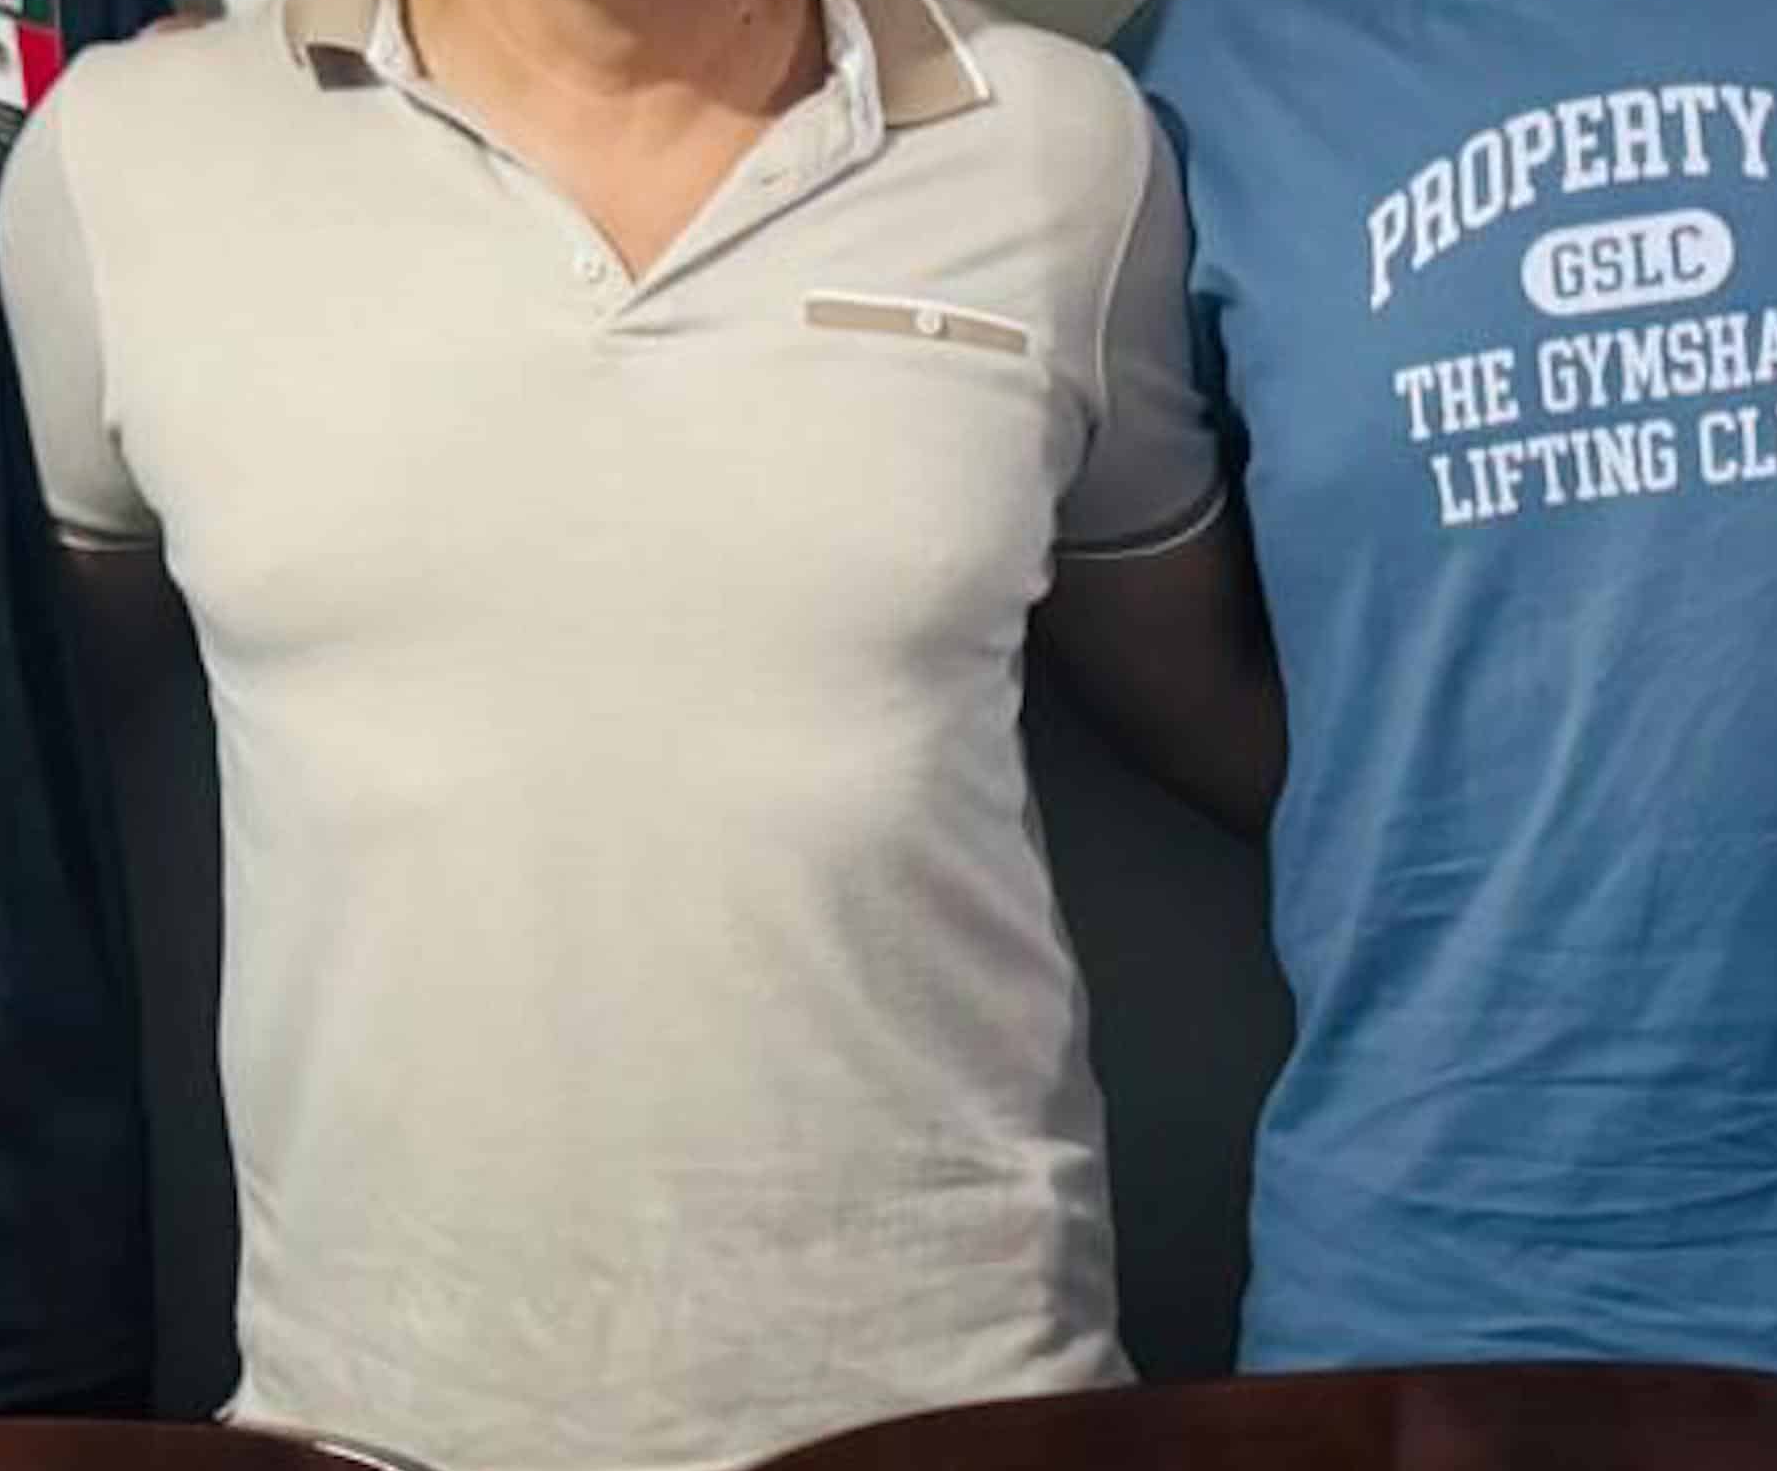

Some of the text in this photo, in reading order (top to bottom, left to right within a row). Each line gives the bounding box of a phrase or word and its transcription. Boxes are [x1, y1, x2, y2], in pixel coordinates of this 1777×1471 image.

[1366, 83, 1774, 313] PROPERTY
[1550, 224, 1708, 300] GSLC
[1393, 349, 1519, 442] THE
[1430, 419, 1678, 528] LIFTING
